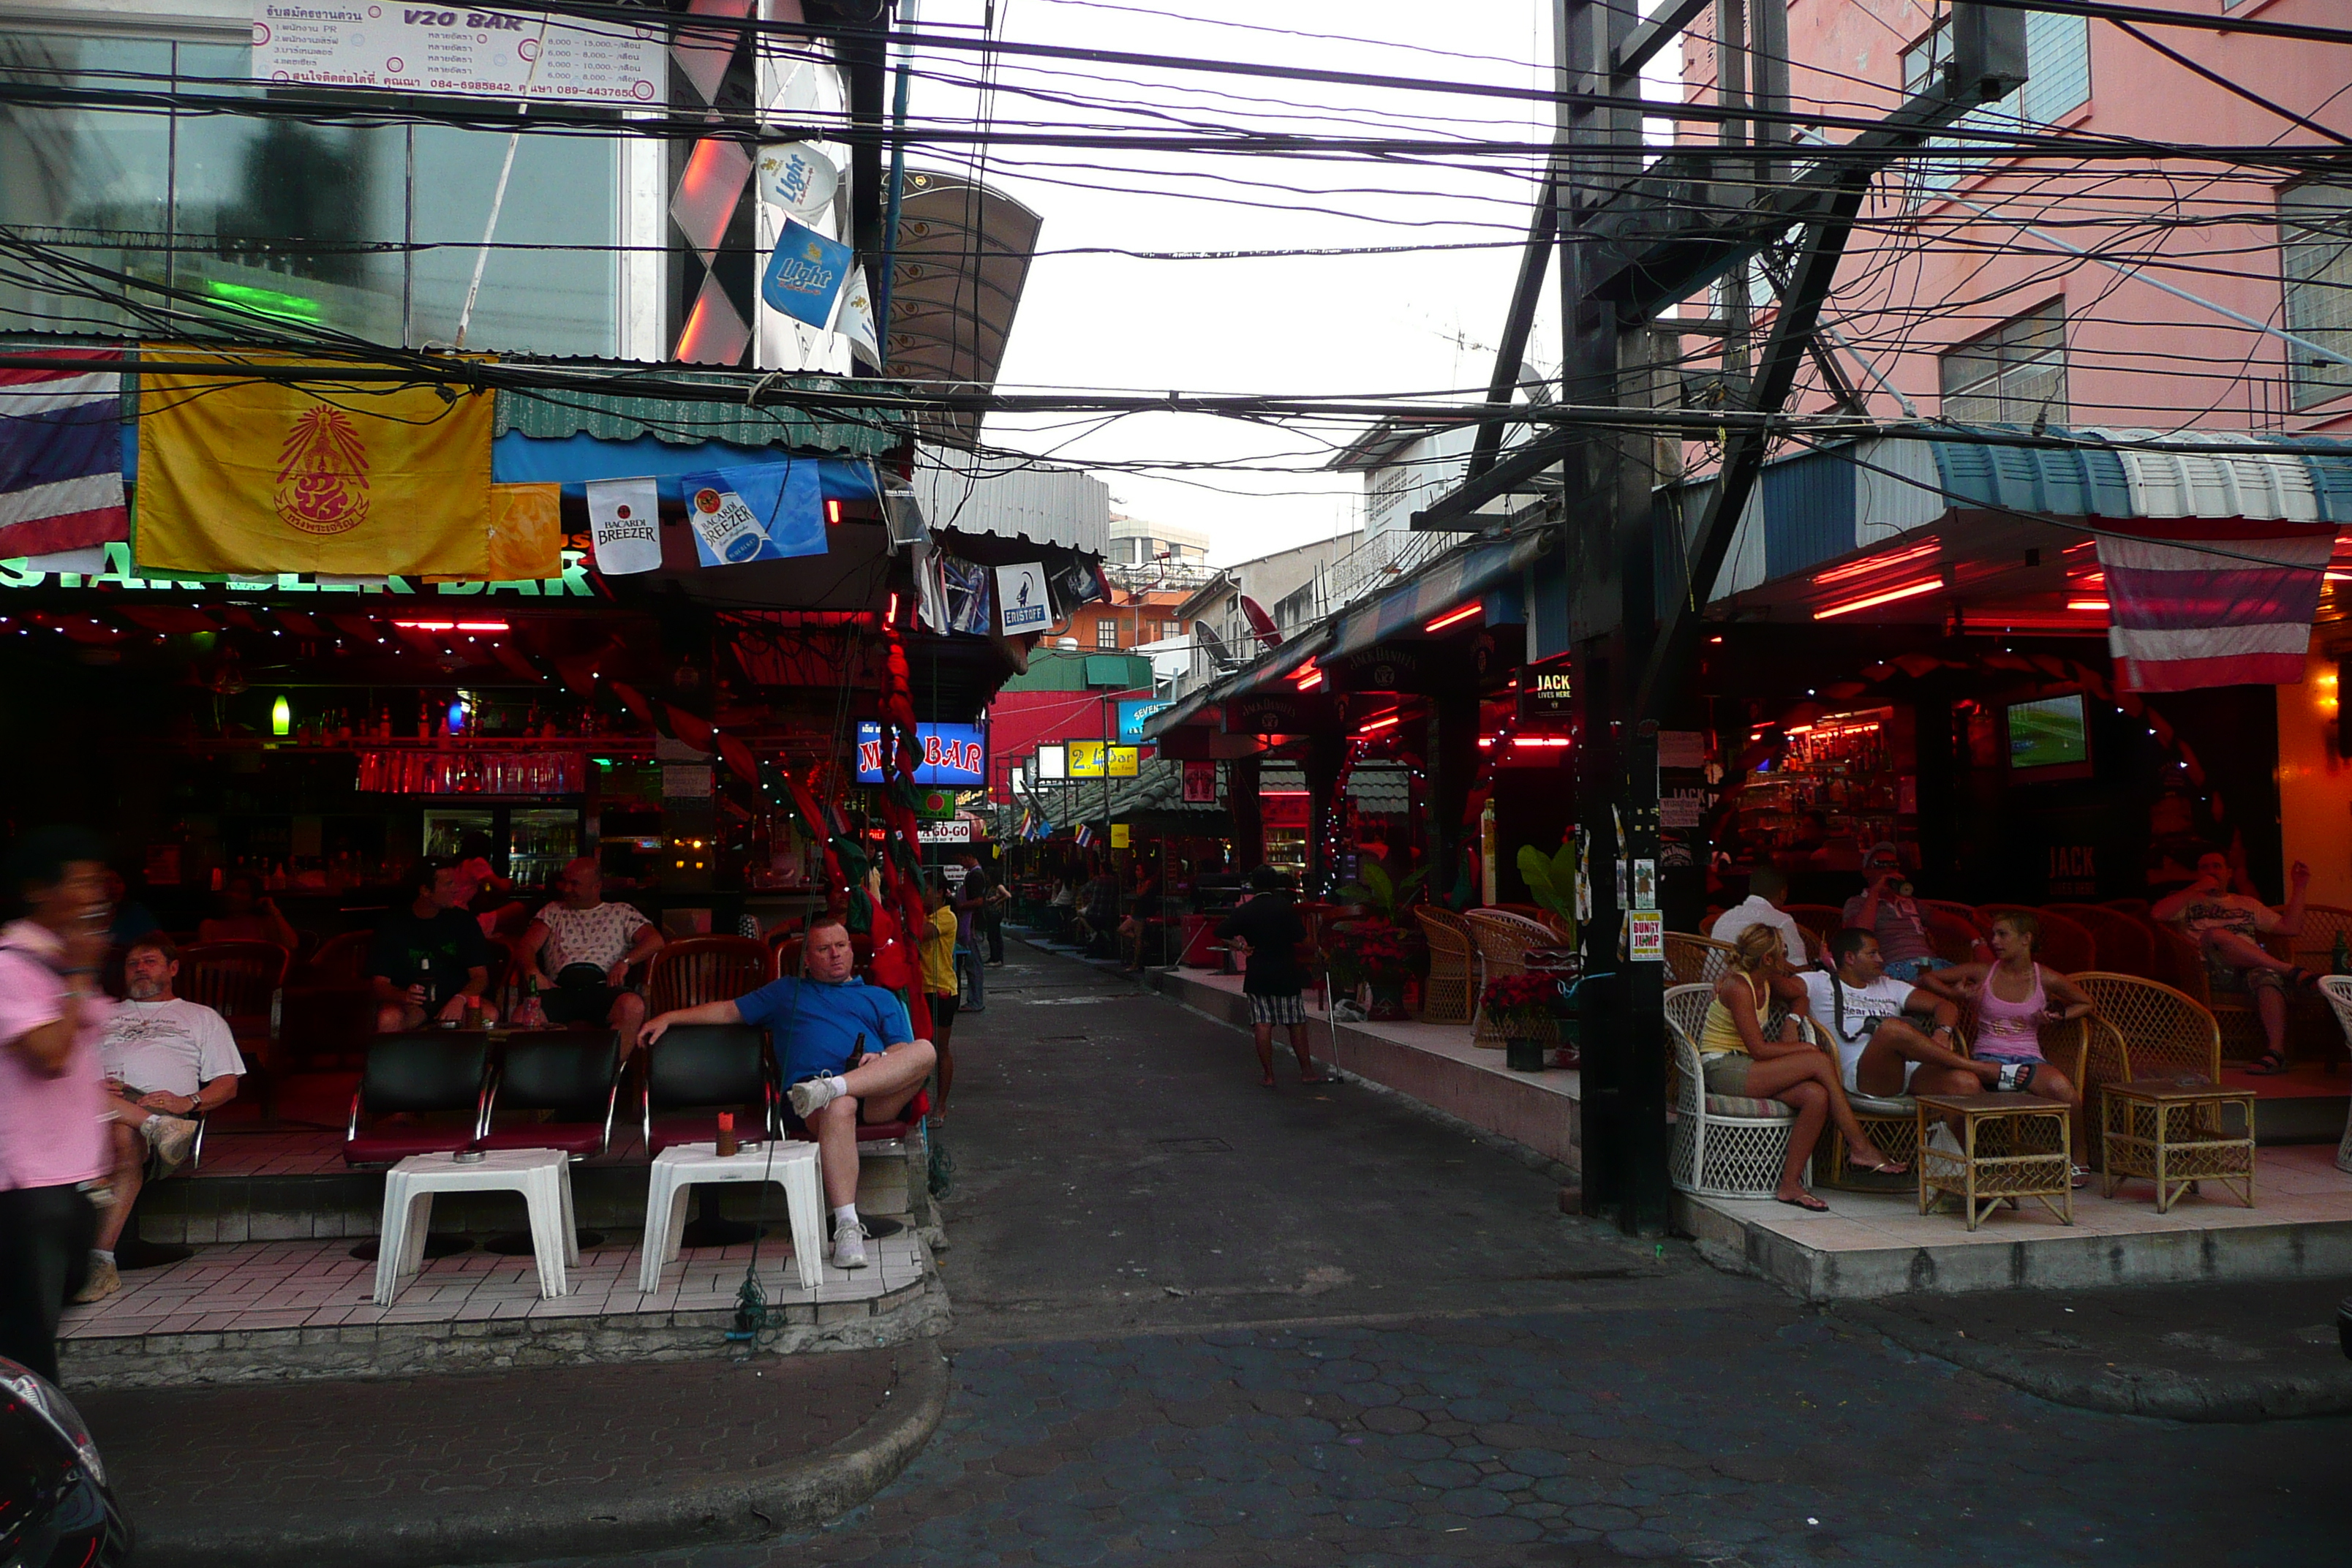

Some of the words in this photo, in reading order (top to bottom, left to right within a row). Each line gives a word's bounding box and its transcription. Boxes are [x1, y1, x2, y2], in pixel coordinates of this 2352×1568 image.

[267, 5, 363, 20] รับสมัครงานด่วน
[404, 10, 458, 26] V20
[467, 13, 524, 31] BAR
[429, 31, 472, 41] หลายอัตรา
[428, 43, 472, 52] หลายอัตรา
[428, 55, 472, 64] หลายอัตรา
[287, 513, 355, 532] ทรงพระเจริญ
[605, 519, 647, 529] BACARDI
[701, 501, 737, 530] BACARDI
[702, 505, 755, 549] BREEZER
[598, 527, 657, 546] BREEZER
[1006, 607, 1042, 624] ERISTOFF
[1537, 674, 1571, 691] JACK
[1134, 704, 1159, 721] SEVEN
[923, 735, 982, 774] BAR
[932, 826, 969, 837] GO-GO
[2048, 845, 2097, 878] JACK
[1633, 921, 1659, 933] BUNGY
[1634, 935, 1659, 947] JUMP
